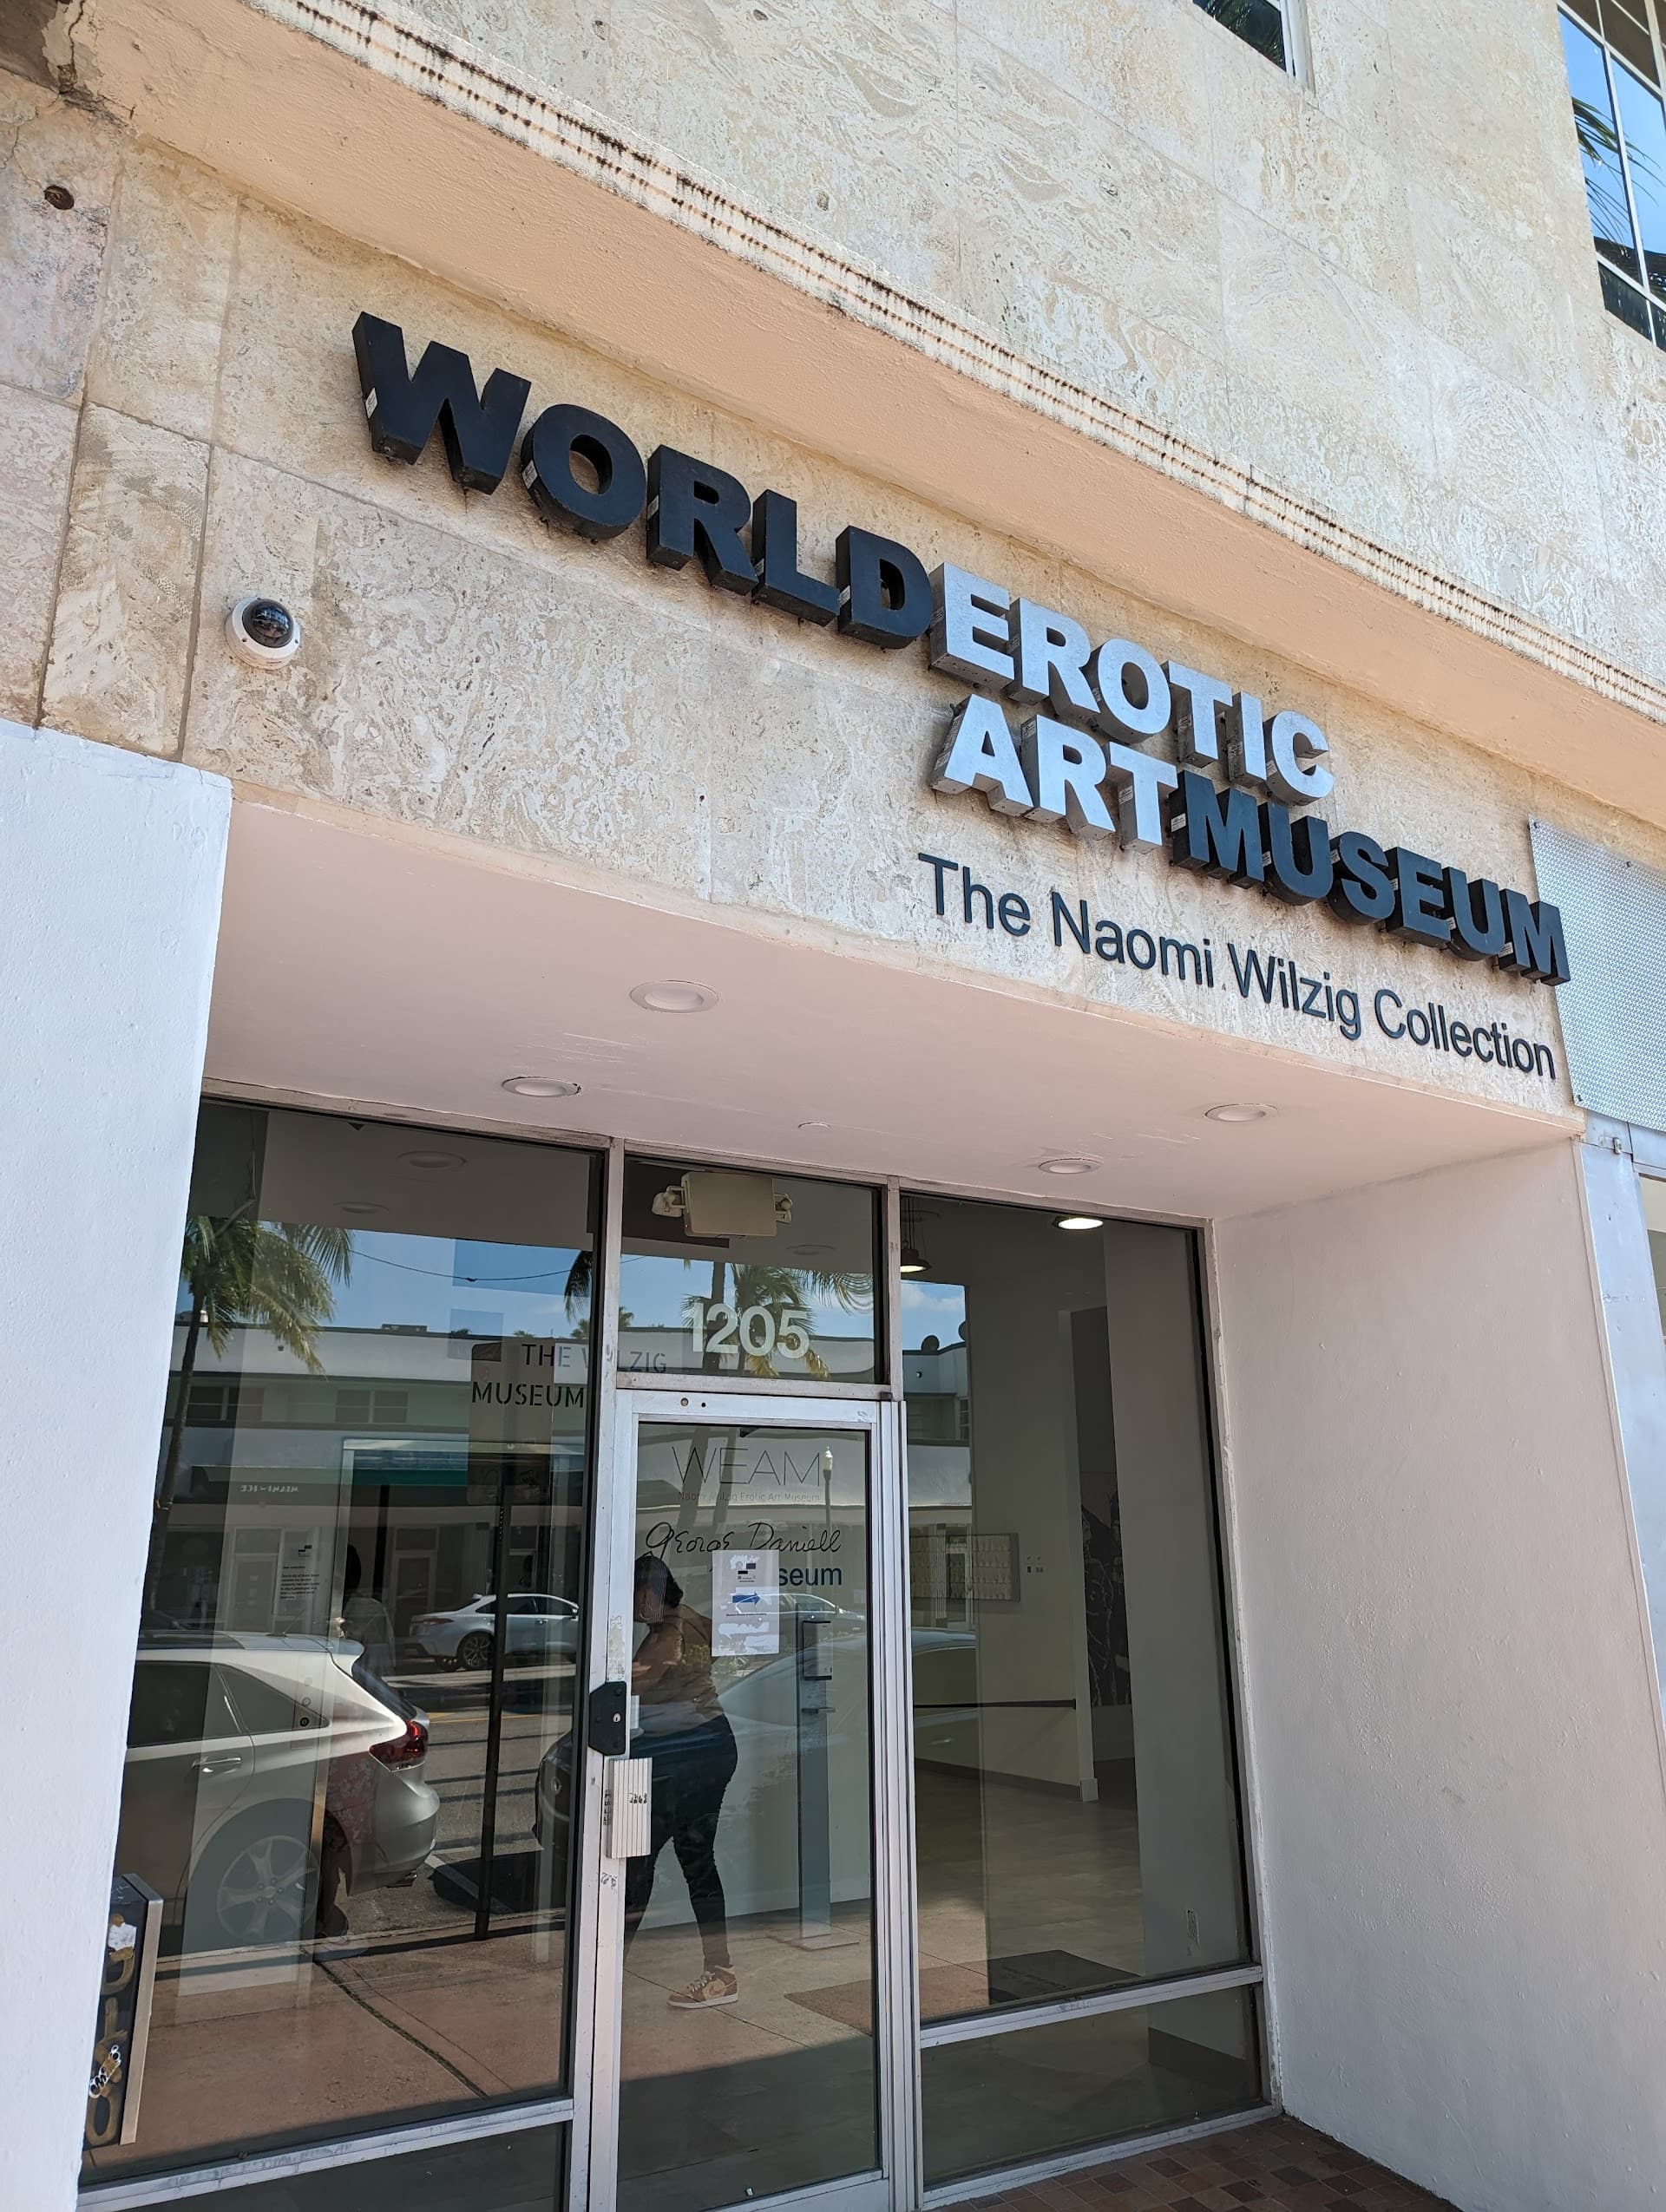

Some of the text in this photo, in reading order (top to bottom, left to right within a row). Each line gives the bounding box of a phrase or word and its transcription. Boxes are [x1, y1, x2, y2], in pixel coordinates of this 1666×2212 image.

[352, 311, 1335, 806] WORLD EROTIC
[931, 694, 1570, 985] ART MUSEUM
[918, 852, 1555, 1079] The Naomi Wilzig Collection
[692, 1302, 810, 1359] 1205
[521, 1344, 571, 1368] THE
[471, 1381, 584, 1409] MUSEUM
[672, 1445, 820, 1487] WEAM
[678, 1491, 706, 1502] Naom
[784, 1492, 820, 1502] Museum
